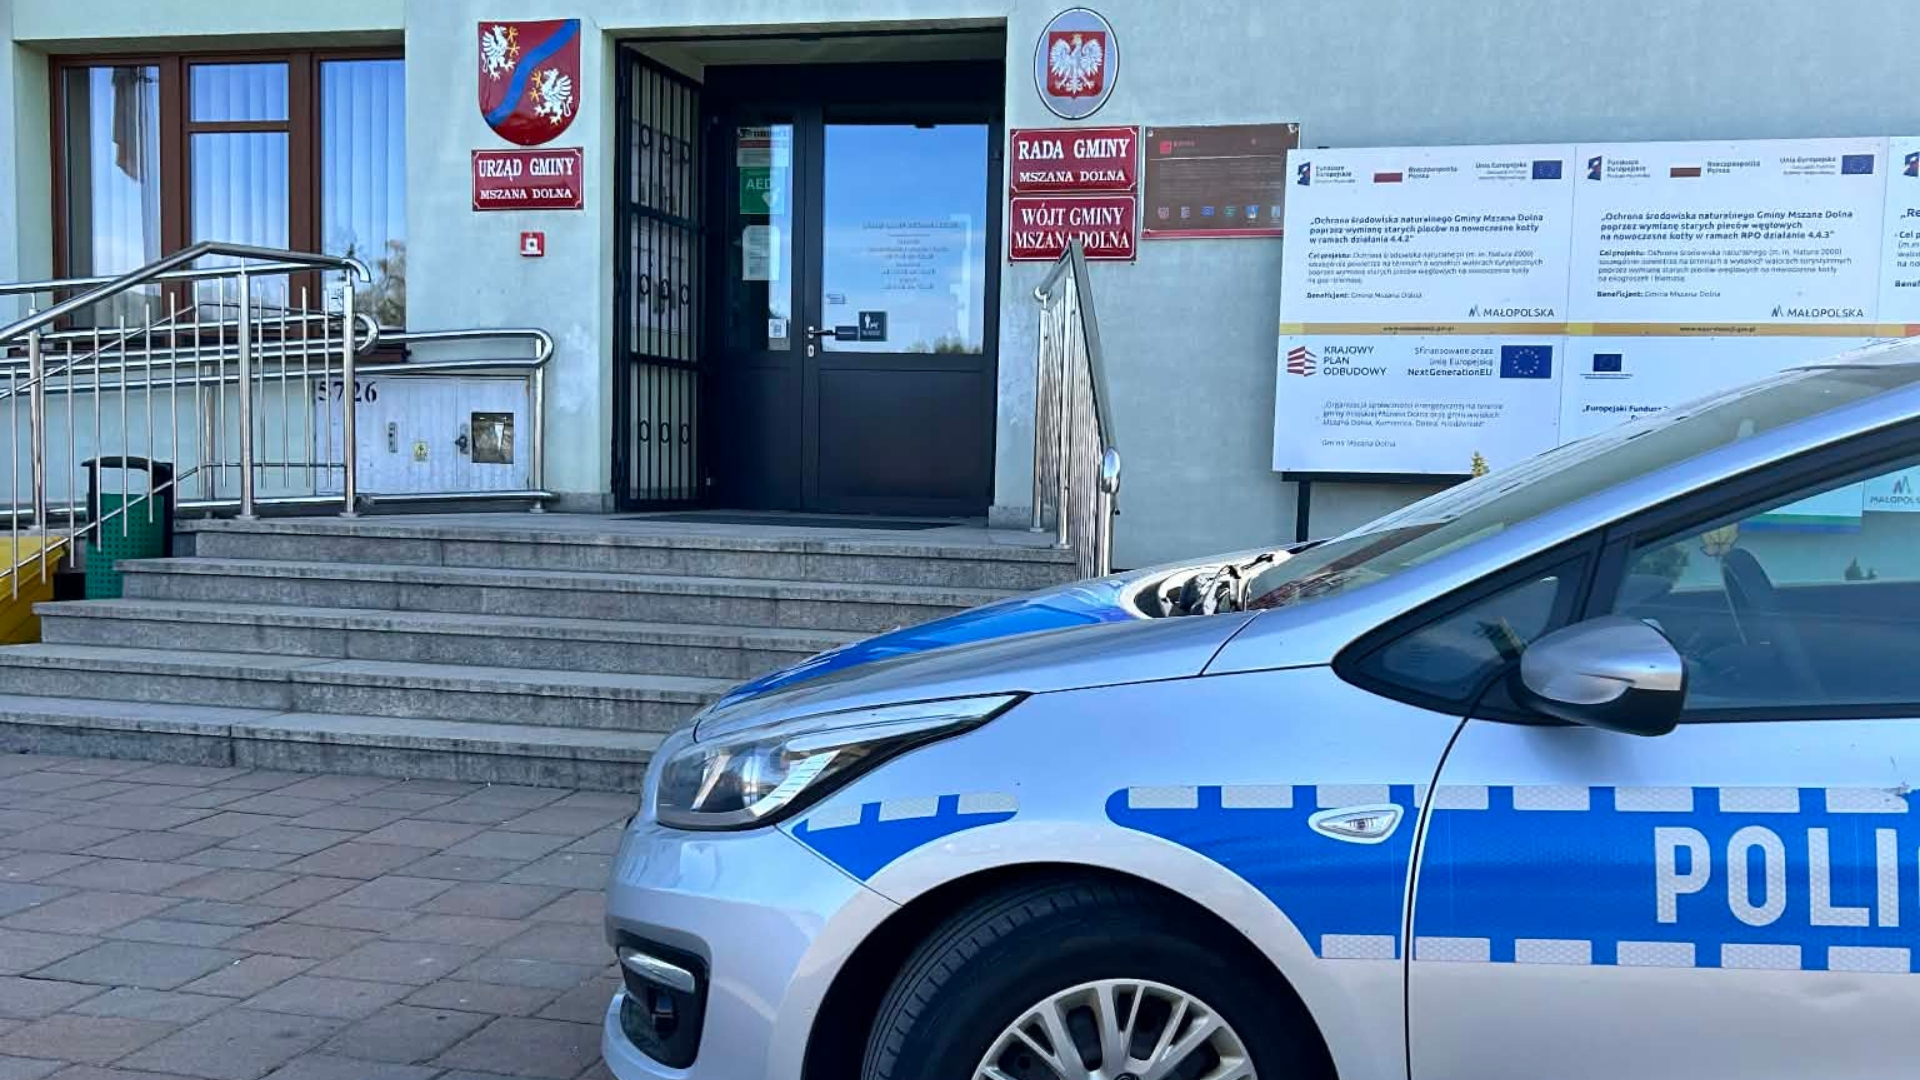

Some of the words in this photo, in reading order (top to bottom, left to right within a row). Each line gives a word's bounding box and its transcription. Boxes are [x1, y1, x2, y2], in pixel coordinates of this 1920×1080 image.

[1018, 140, 1064, 160] RADA
[1073, 138, 1130, 159] GMINY
[478, 159, 522, 182] URZĄD
[530, 157, 574, 176] GMINY
[1019, 171, 1074, 183] MSZANA
[1079, 170, 1125, 182] DOLNA
[480, 189, 528, 200] MSZANA
[532, 188, 573, 199] DOLNA
[1020, 202, 1066, 226] WÓJT
[1069, 206, 1124, 226] GMINY
[1351, 216, 1398, 224] środowiska
[1400, 215, 1452, 224] naturalnego
[1454, 214, 1481, 223] Gminy
[1484, 214, 1516, 222] Mszana
[1518, 213, 1543, 221] Dolna
[1645, 212, 1696, 220] środowiska
[1698, 211, 1755, 221] naturalnego
[1757, 211, 1785, 220] Gminy
[1788, 211, 1823, 219] Mszana
[1825, 210, 1853, 219] Dolna
[1385, 225, 1415, 234] starych
[1417, 224, 1447, 234] pieców
[1600, 223, 1637, 232] poprzez
[1639, 222, 1679, 232] wymianę
[1681, 222, 1715, 232] starych
[1717, 221, 1749, 231] pieców
[1079, 231, 1130, 248] DOLNA
[1705, 231, 1738, 240] ramach
[1741, 231, 1761, 239] RPO
[1483, 307, 1554, 318] MAŁOPOLSKA
[1787, 307, 1864, 318] MAŁOPOLSKA
[1324, 345, 1375, 355] KRAJOWY
[1414, 346, 1470, 355] Sfinansowane
[1471, 348, 1494, 357] przez
[1323, 356, 1350, 365] PLAN
[1323, 366, 1387, 376] ODBUDOWY
[1407, 367, 1493, 377] NextGenerationEU
[1654, 825, 1920, 928] POLI
